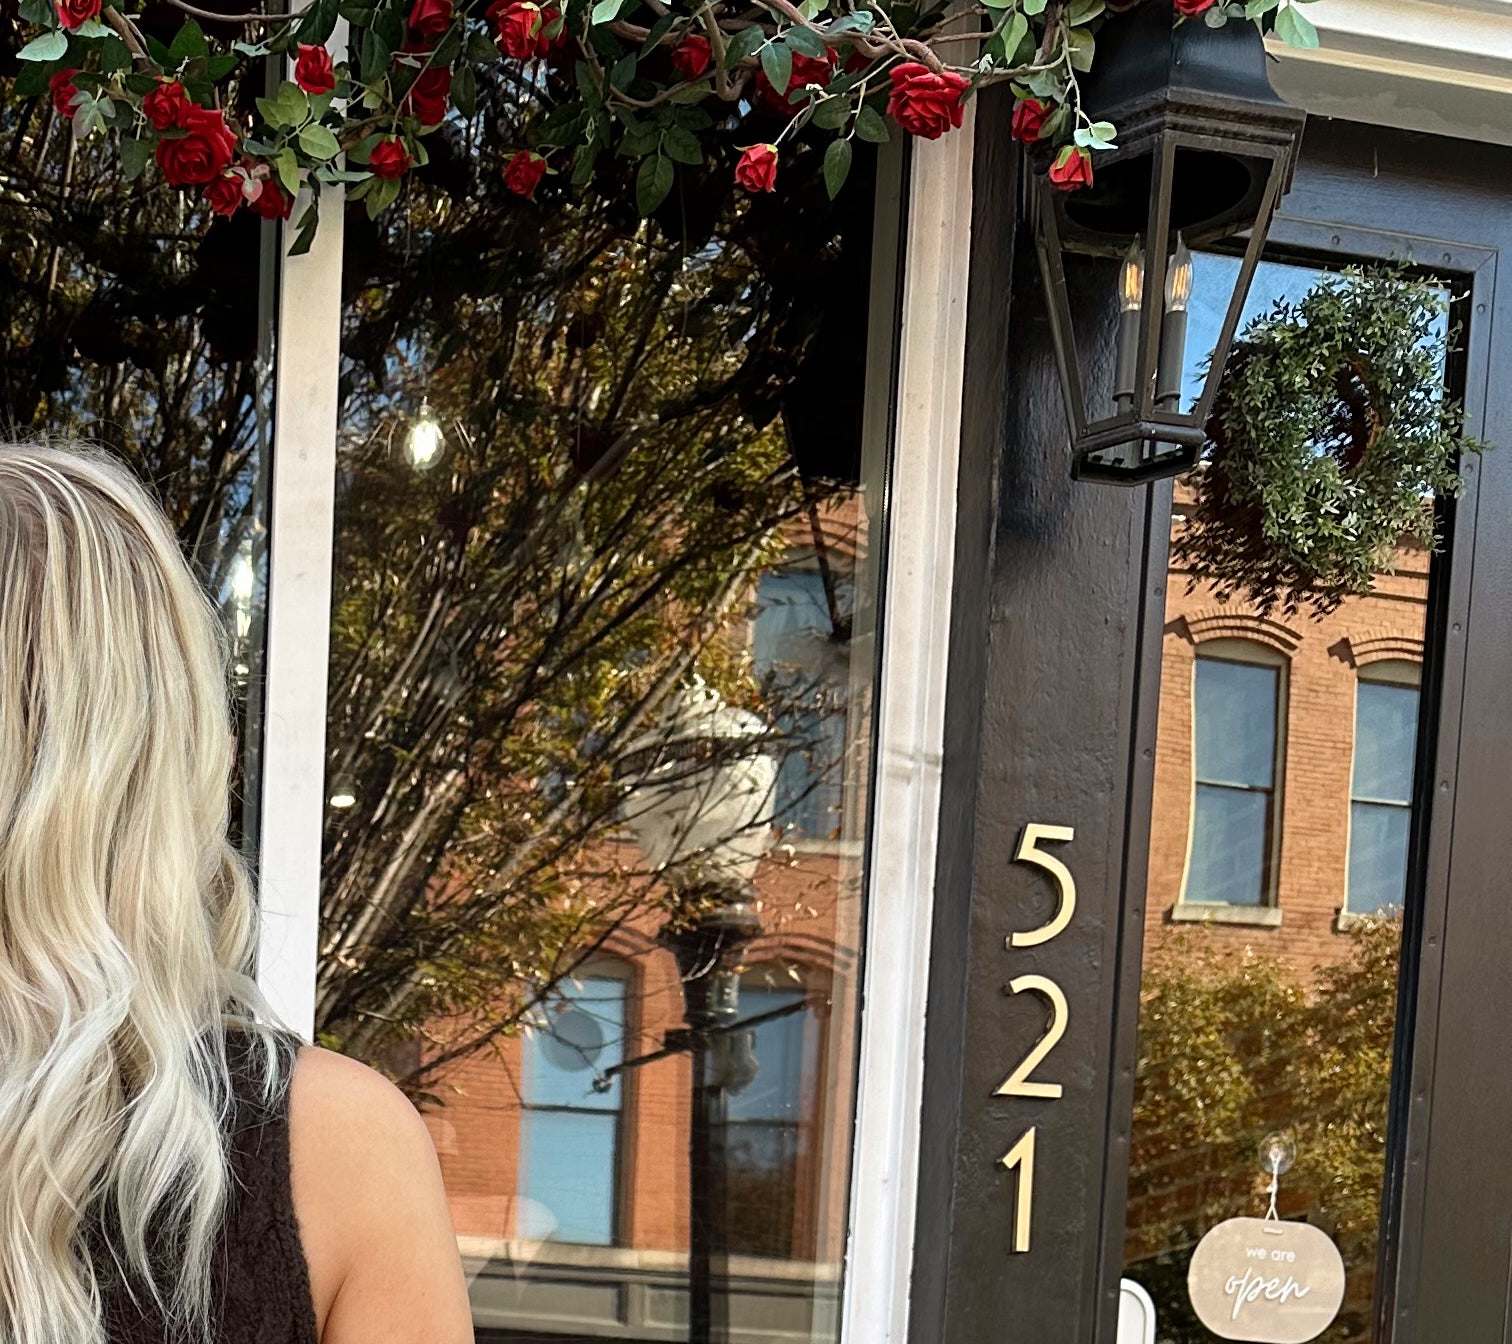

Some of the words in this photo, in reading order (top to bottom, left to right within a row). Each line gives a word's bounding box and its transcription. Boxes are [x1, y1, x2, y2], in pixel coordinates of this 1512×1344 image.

[995, 822, 1076, 1253] 521
[1246, 1247, 1267, 1260] we
[1270, 1249, 1296, 1263] are
[1224, 1266, 1311, 1320] open
